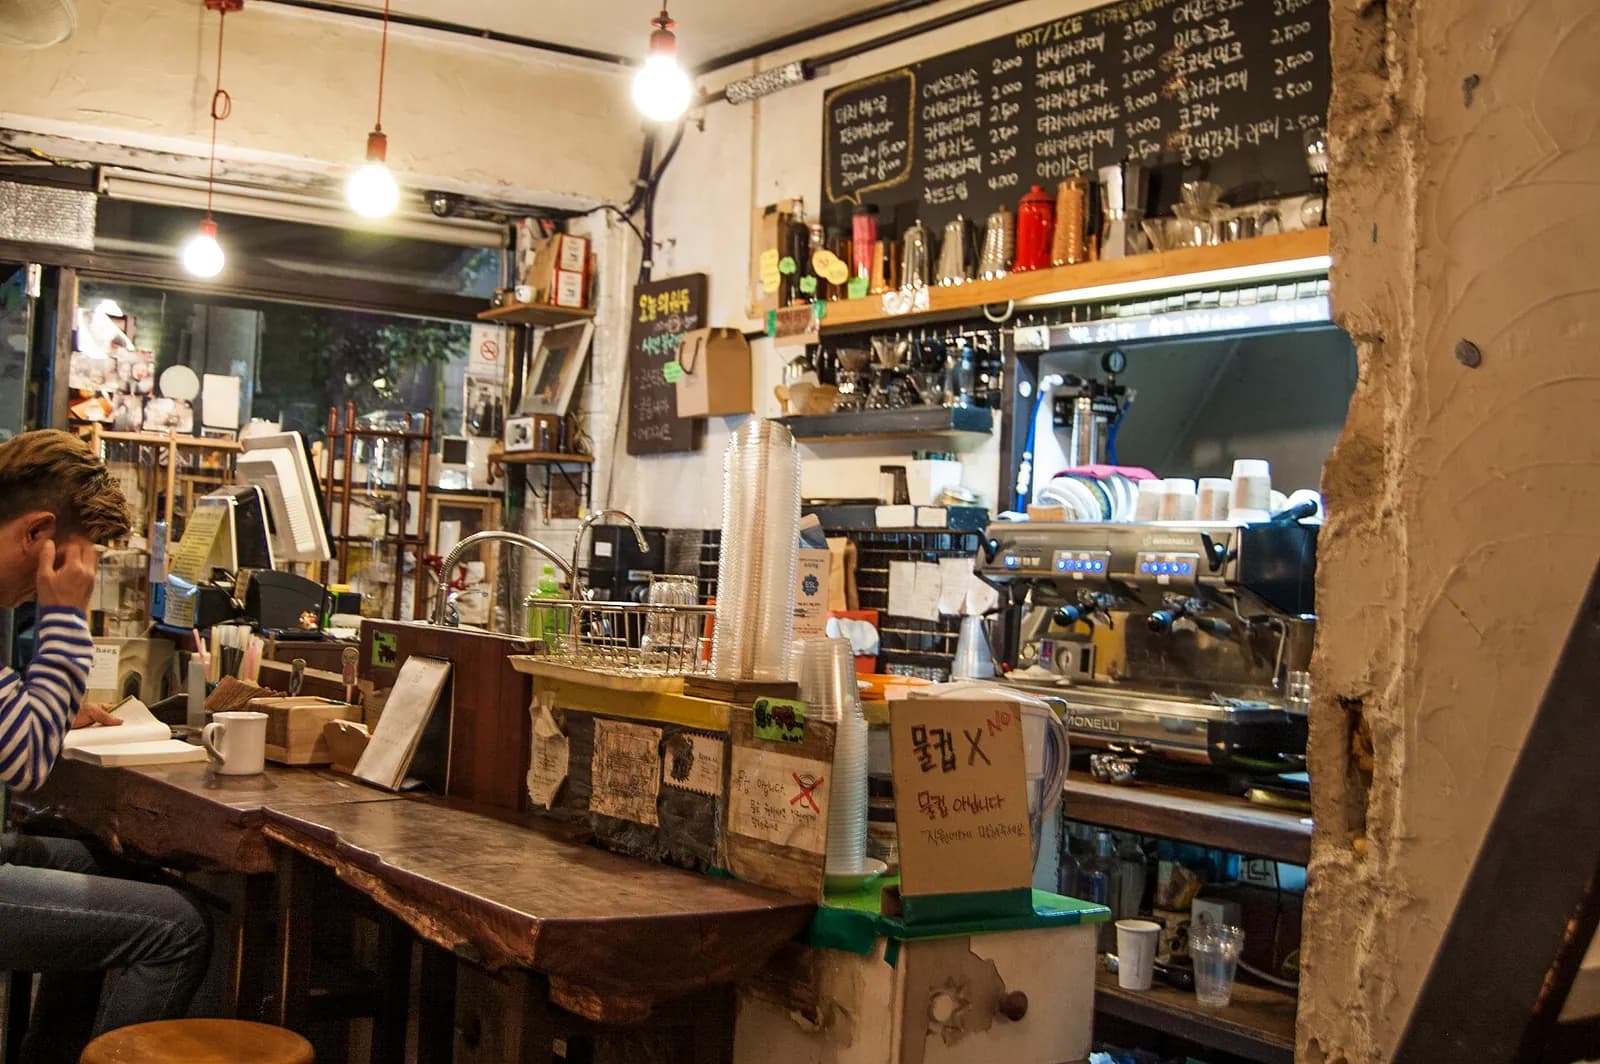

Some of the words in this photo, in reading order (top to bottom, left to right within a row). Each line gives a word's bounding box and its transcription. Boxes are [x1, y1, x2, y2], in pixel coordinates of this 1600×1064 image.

[1015, 15, 1083, 49] HOT/ICE
[922, 88, 984, 120] 아메리카노
[986, 710, 1011, 736] NO
[911, 724, 956, 773] 물컵
[963, 728, 991, 766] X
[917, 790, 948, 820] 물컵
[952, 793, 1005, 815] 아닙니다
